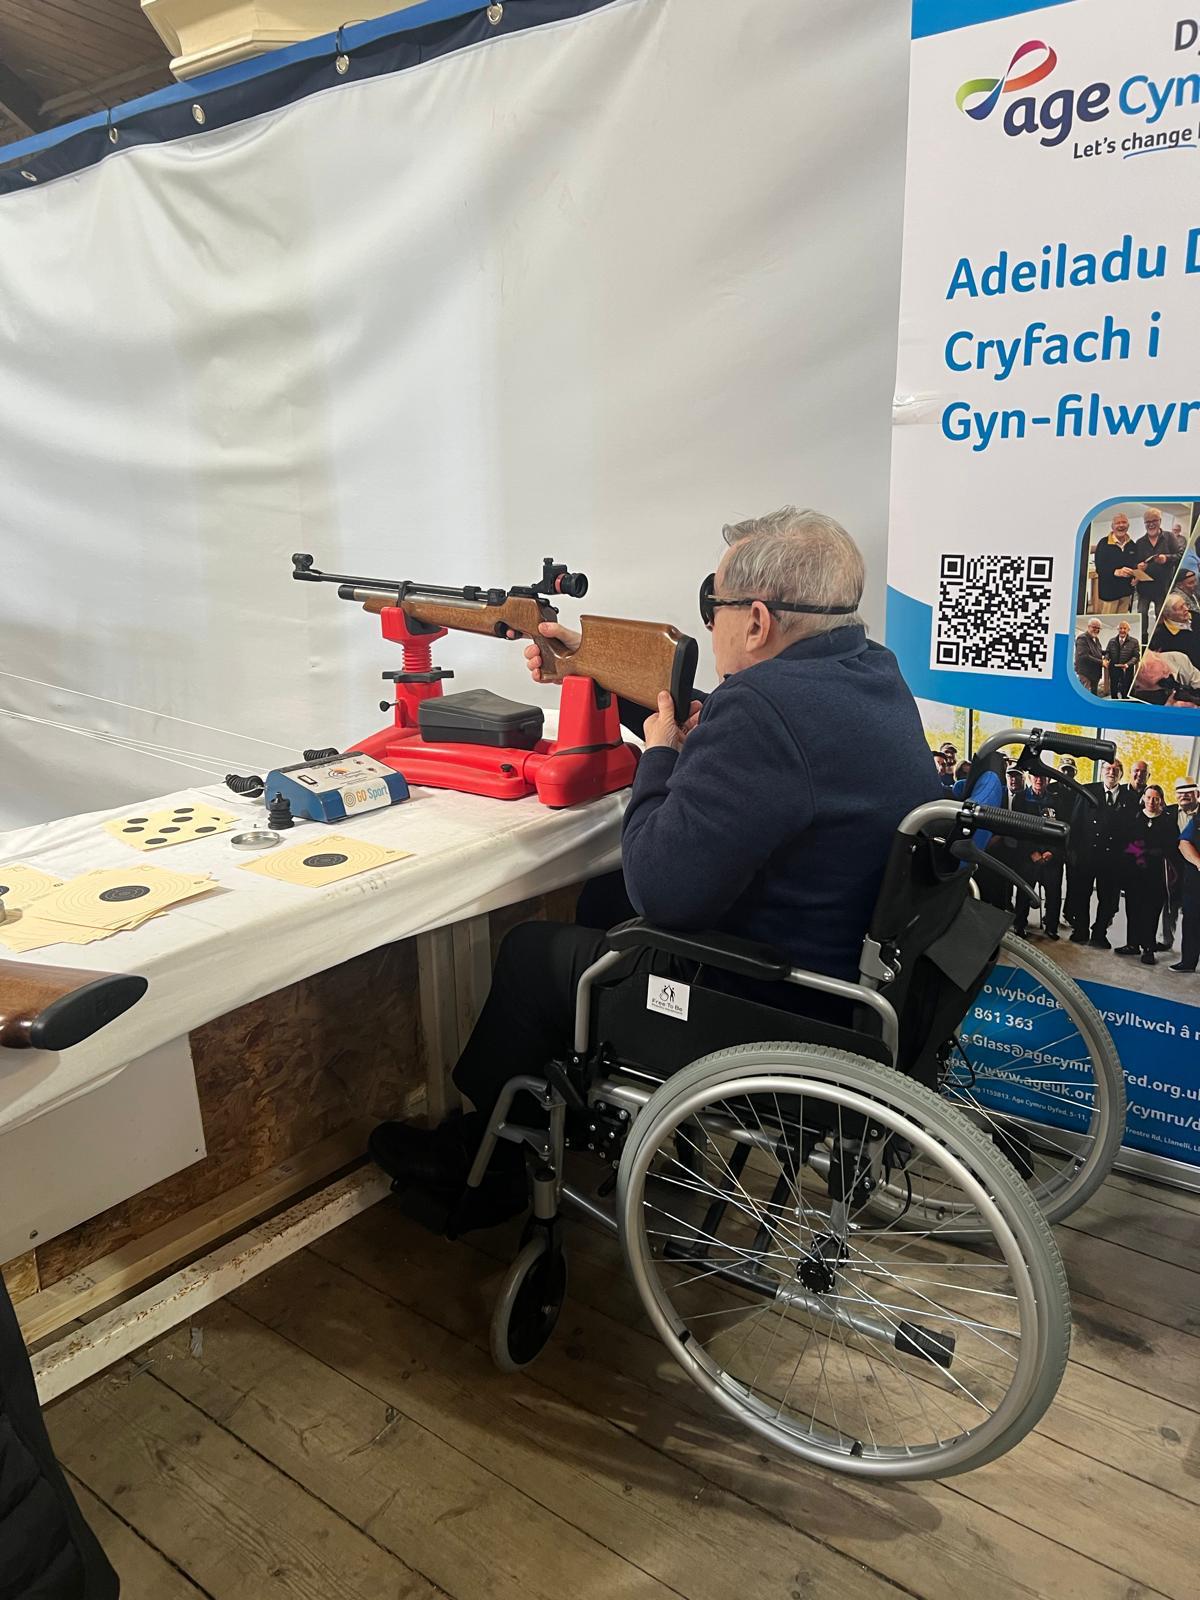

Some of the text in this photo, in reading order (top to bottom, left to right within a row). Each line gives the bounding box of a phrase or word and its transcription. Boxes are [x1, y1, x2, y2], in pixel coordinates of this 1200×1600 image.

[1175, 19, 1200, 56] D
[1003, 82, 1111, 147] age
[1073, 137, 1116, 159] Let's
[1121, 128, 1192, 150] change
[946, 234, 1167, 299] Adeiladu
[945, 311, 1162, 381] Cryfach i
[367, 785, 389, 801] Sport
[996, 986, 1063, 1010] wybodae
[1099, 1009, 1176, 1036] ysylltwch
[1180, 1025, 1190, 1039] â
[1005, 1014, 1034, 1031] 363
